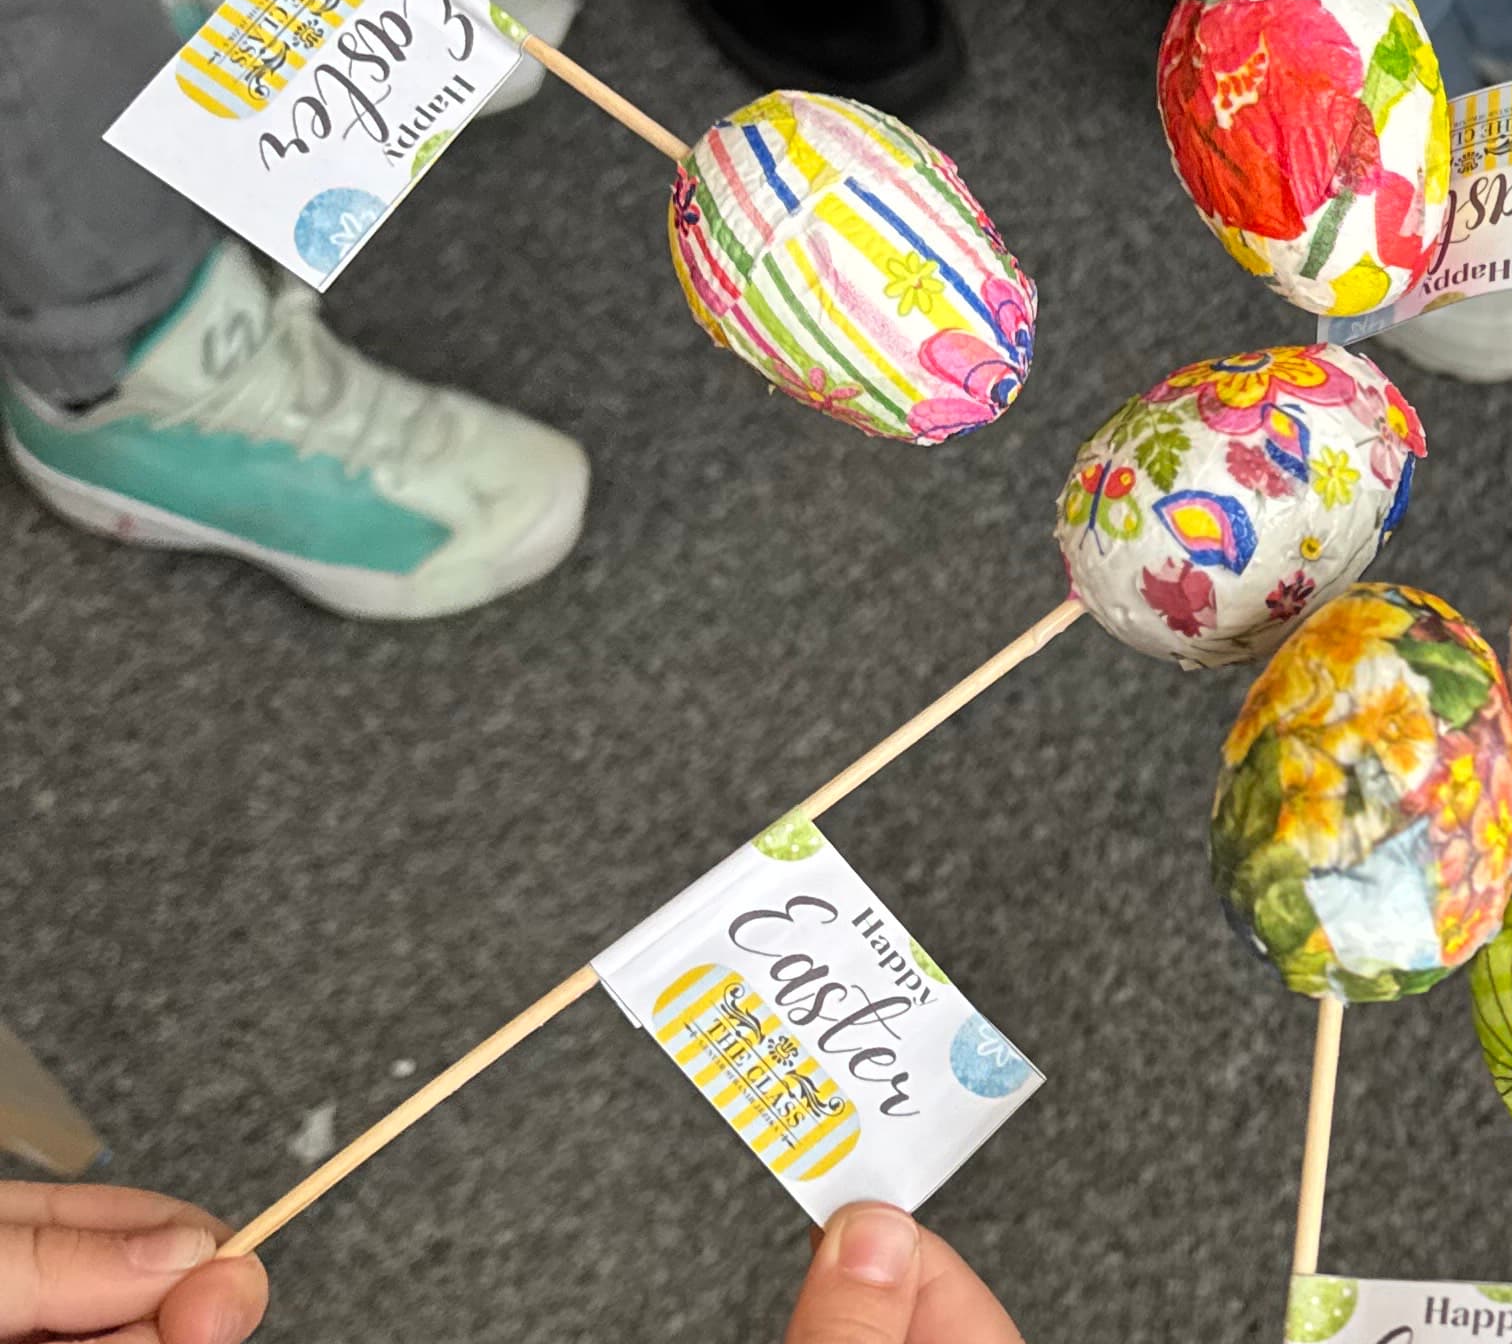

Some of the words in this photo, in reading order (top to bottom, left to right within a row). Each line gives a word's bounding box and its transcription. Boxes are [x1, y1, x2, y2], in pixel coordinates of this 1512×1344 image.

[230, 7, 287, 66] CLASS
[386, 74, 476, 167] Happy
[1420, 259, 1511, 297] Happy
[850, 906, 939, 1006] Happy
[728, 894, 920, 1117] Easter
[708, 1019, 751, 1066] THE
[748, 1067, 804, 1127] CLASS
